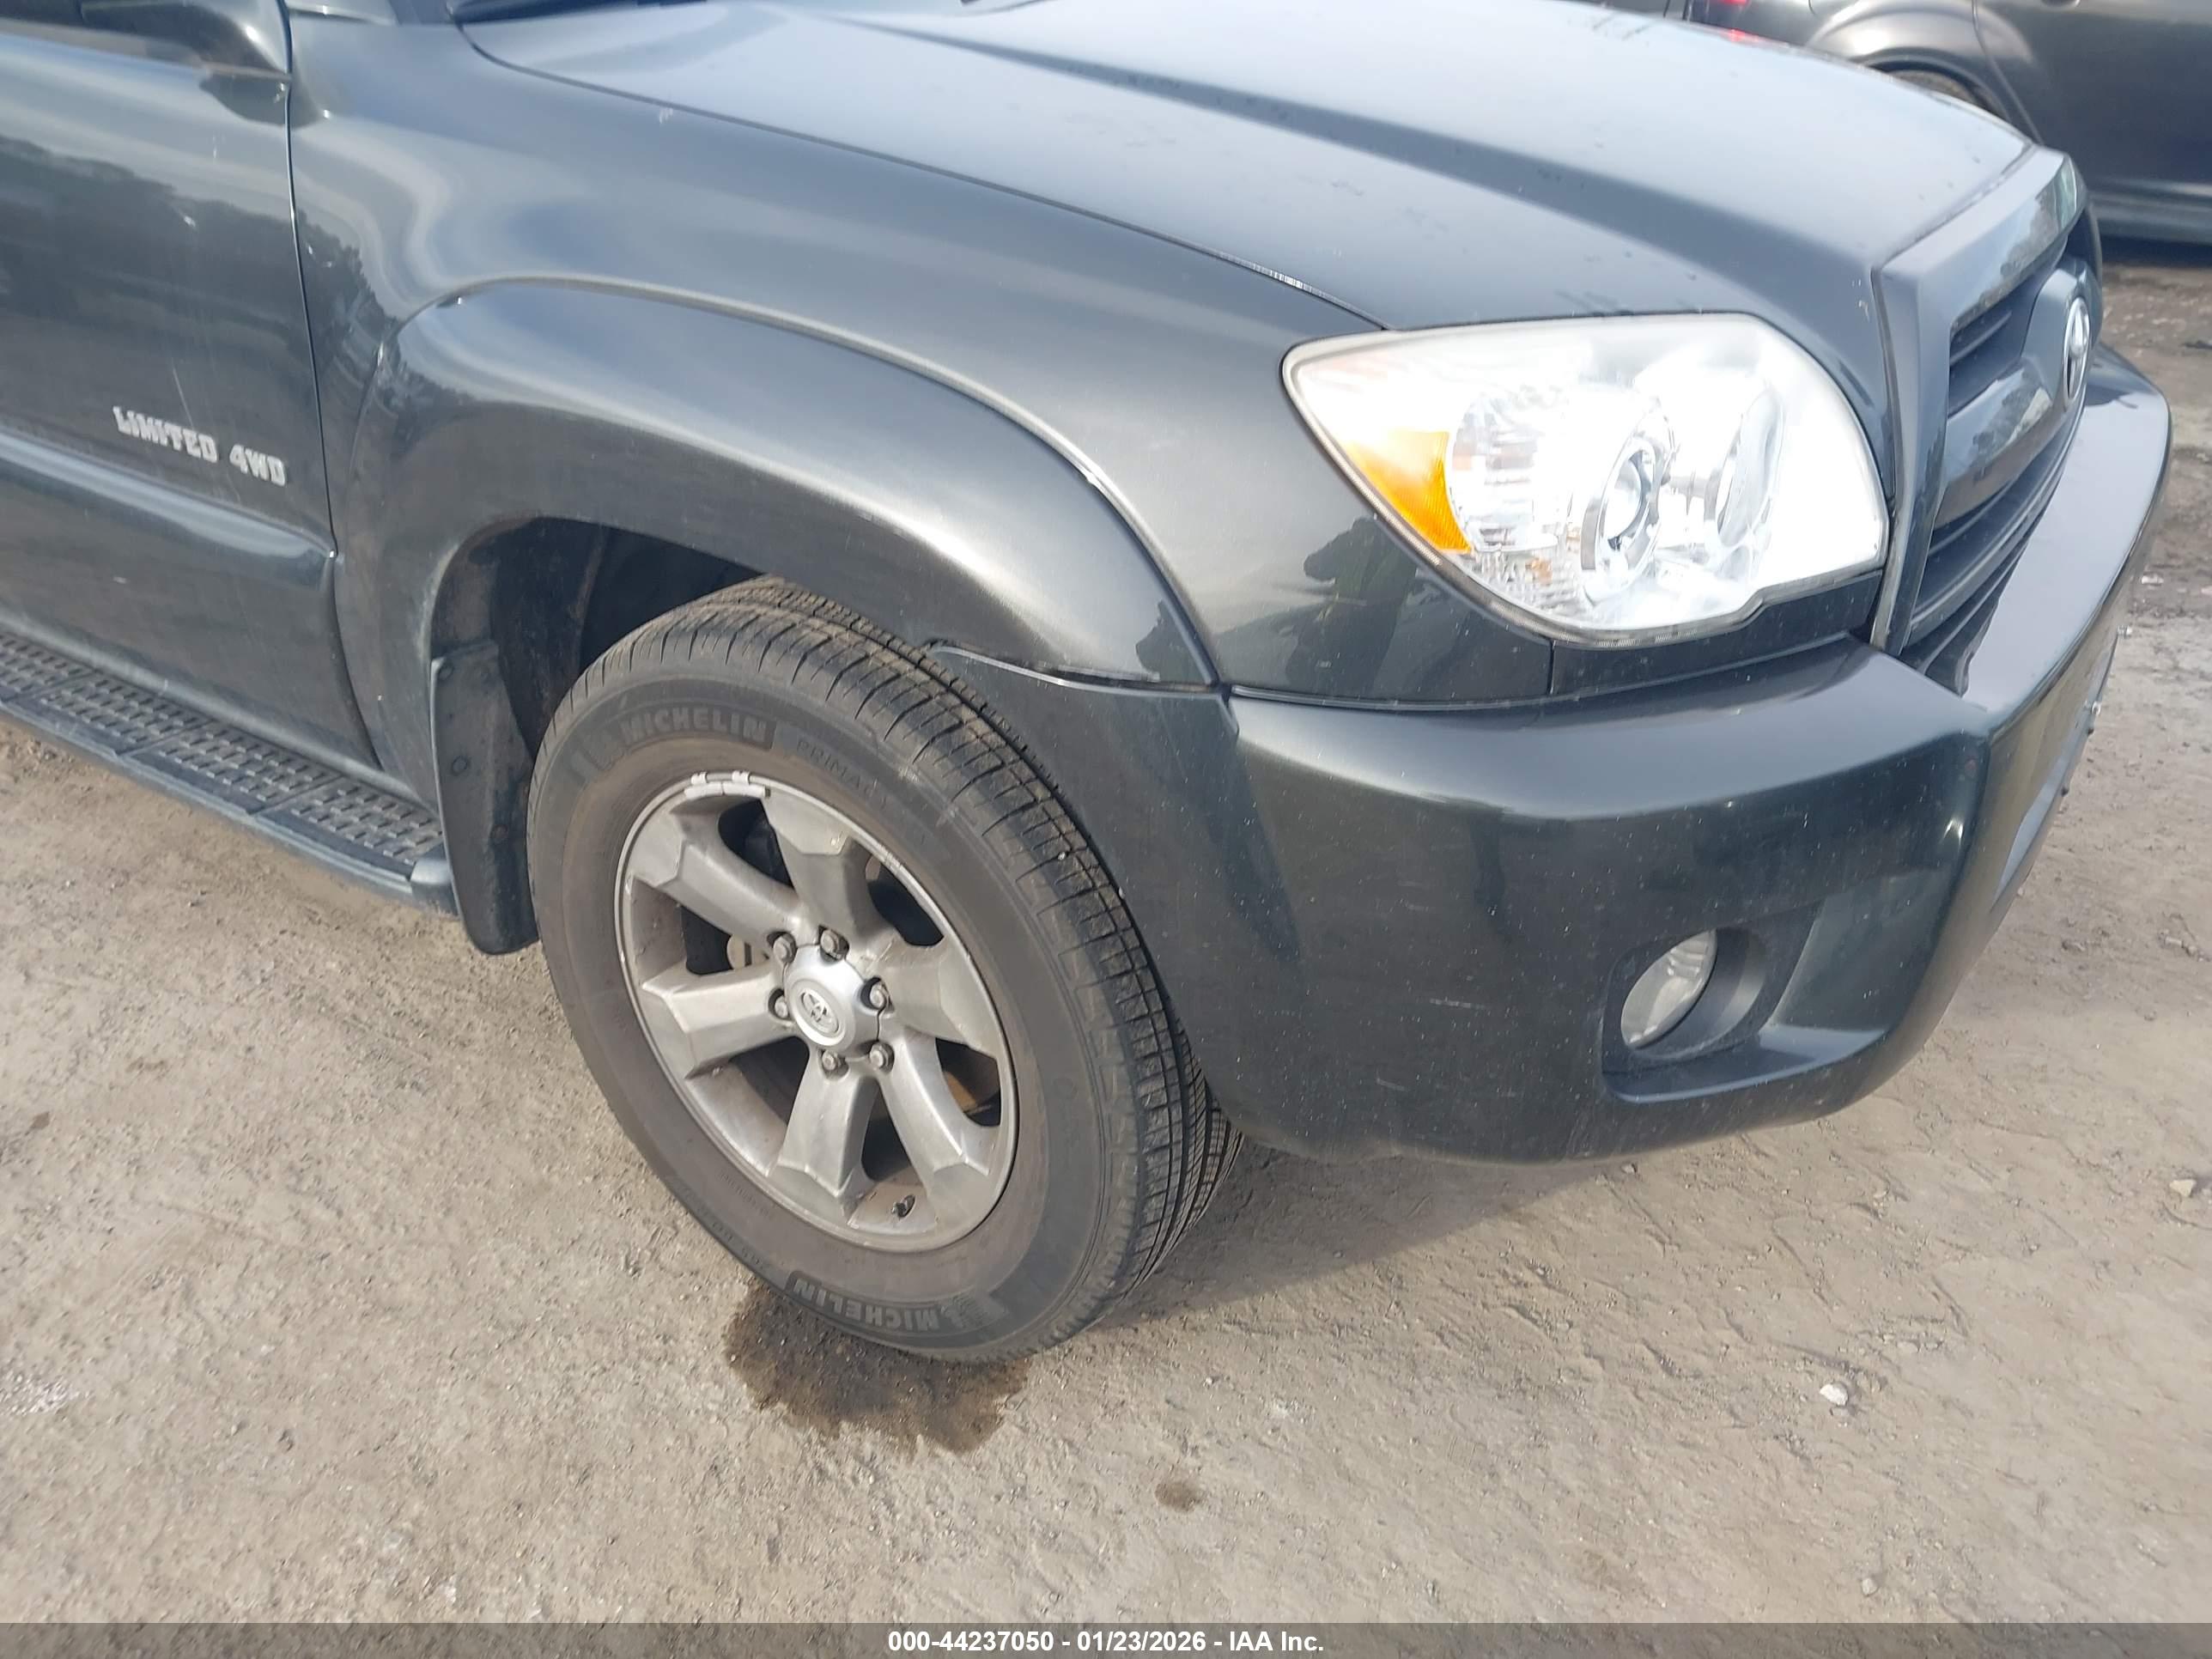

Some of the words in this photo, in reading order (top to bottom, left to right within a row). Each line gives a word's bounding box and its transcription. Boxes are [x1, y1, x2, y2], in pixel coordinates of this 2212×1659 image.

[112, 405, 218, 464] LIMITED
[228, 443, 286, 488] 4WD
[620, 707, 768, 745] MICHELIN
[792, 1277, 941, 1332] MICHELIN
